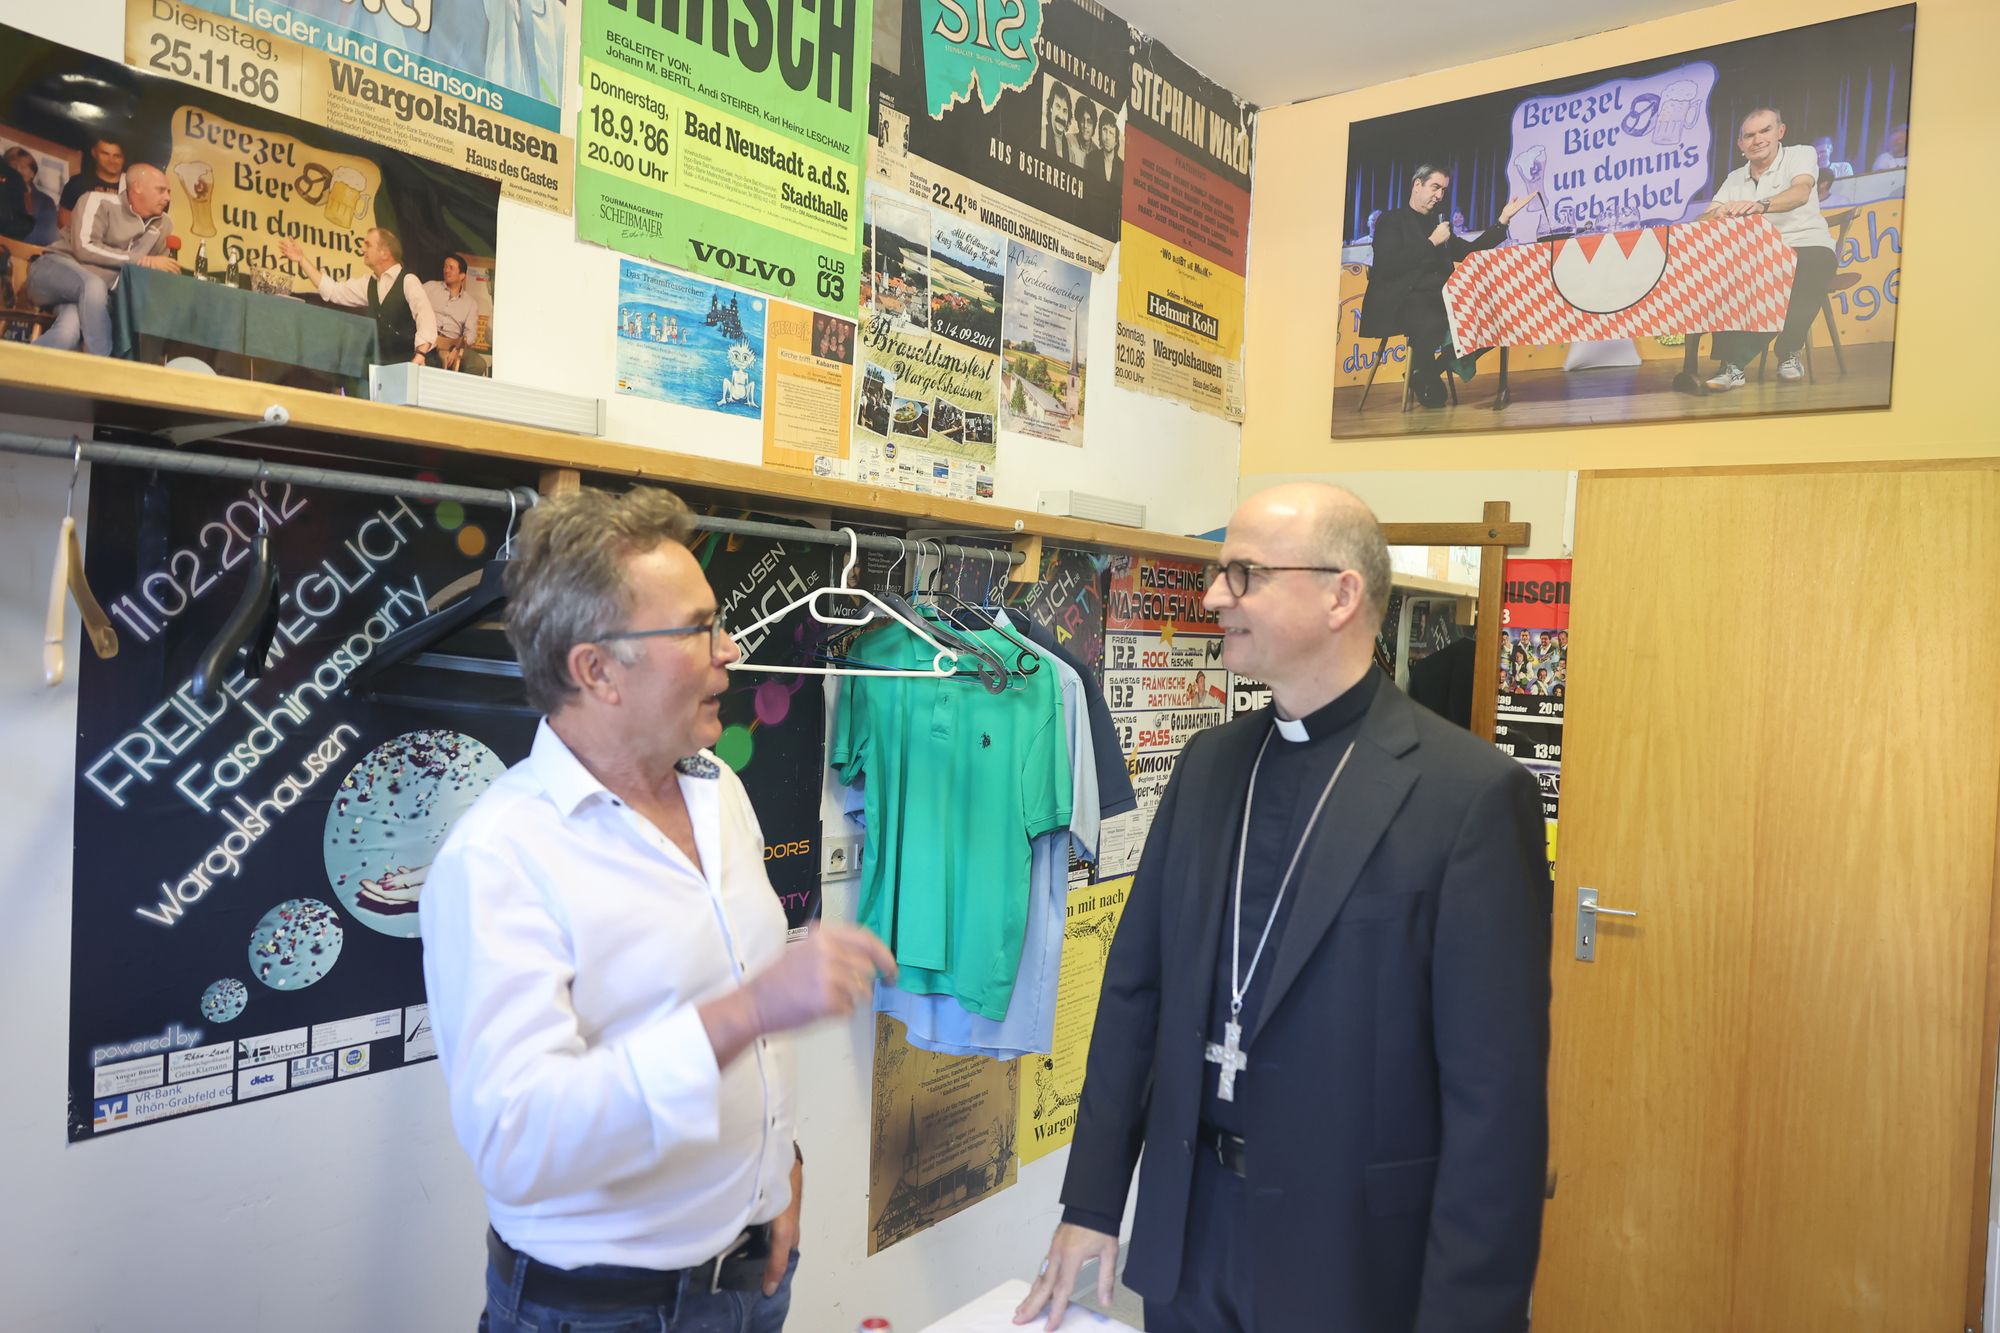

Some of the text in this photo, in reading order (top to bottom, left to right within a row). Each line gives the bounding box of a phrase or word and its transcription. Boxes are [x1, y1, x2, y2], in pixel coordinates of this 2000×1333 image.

[152, 0, 279, 62] Dienstag,
[150, 33, 279, 104] 25.11.86
[230, 0, 320, 45] Lieder
[327, 32, 378, 66] und
[383, 48, 504, 111] Chansons
[607, 30, 692, 75] BEGLEITET VON:
[1038, 36, 1117, 99] COUNTRY-ROCK
[329, 58, 558, 165] Wargolshausen
[590, 72, 670, 120] Donnerstag,
[606, 46, 850, 154] Johann M. BERTL, Andi STEIRER, Karl Heinz LESCHANZ
[1130, 62, 1206, 149] STEPHAN
[685, 110, 721, 147] Bad
[725, 126, 804, 178] Neustadt
[808, 164, 850, 195] a.d.S.
[1564, 125, 1620, 155] Bier
[466, 147, 497, 171] Haus
[499, 159, 519, 178] des
[521, 166, 558, 191] Gastes
[588, 141, 634, 172] 20.00
[639, 158, 669, 183] Uhr
[989, 137, 1084, 200] AUS ÖSTERREICH
[1553, 143, 1700, 192] un domm's
[600, 194, 664, 219] TOURMANAGEMENT
[781, 182, 848, 222] Stadthalle
[222, 204, 368, 257] un domm's
[980, 206, 1060, 253] WARGOLSHAUSEN
[1060, 245, 1075, 258] Haus
[1076, 252, 1087, 264] des
[689, 238, 796, 287] VOLVO
[818, 254, 845, 274] CLUB
[1007, 246, 1025, 267] 40
[1149, 295, 1191, 327] Helmut
[1192, 312, 1217, 337] Kohl
[864, 315, 994, 381] Brauchtumsfest
[1116, 343, 1145, 369] 12.10.86
[1153, 339, 1222, 379] Wargolshausen
[890, 360, 983, 402] Wargolshausen
[1115, 366, 1132, 381] 20.00
[1133, 370, 1145, 384] Uhr
[722, 541, 786, 620] HAUSEN
[1140, 565, 1204, 592] FASCHING
[1111, 636, 1137, 645] FREITAG
[1142, 650, 1170, 667] ROCK
[1109, 677, 1140, 685] SAMSTAG
[1113, 716, 1137, 724] ONNTAG
[1138, 729, 1171, 747] SPASS
[1533, 743, 1561, 760] 13.00
[135, 722, 361, 926] Wargolshausen
[1077, 896, 1096, 914] mit
[1099, 889, 1124, 909] nach
[94, 1026, 200, 1066] powered by
[135, 1086, 182, 1103] VR-Bank
[135, 1089, 216, 1115] Rhön-Grabfeld
[219, 1086, 233, 1097] eG
[1034, 1109, 1077, 1143] Wargol
